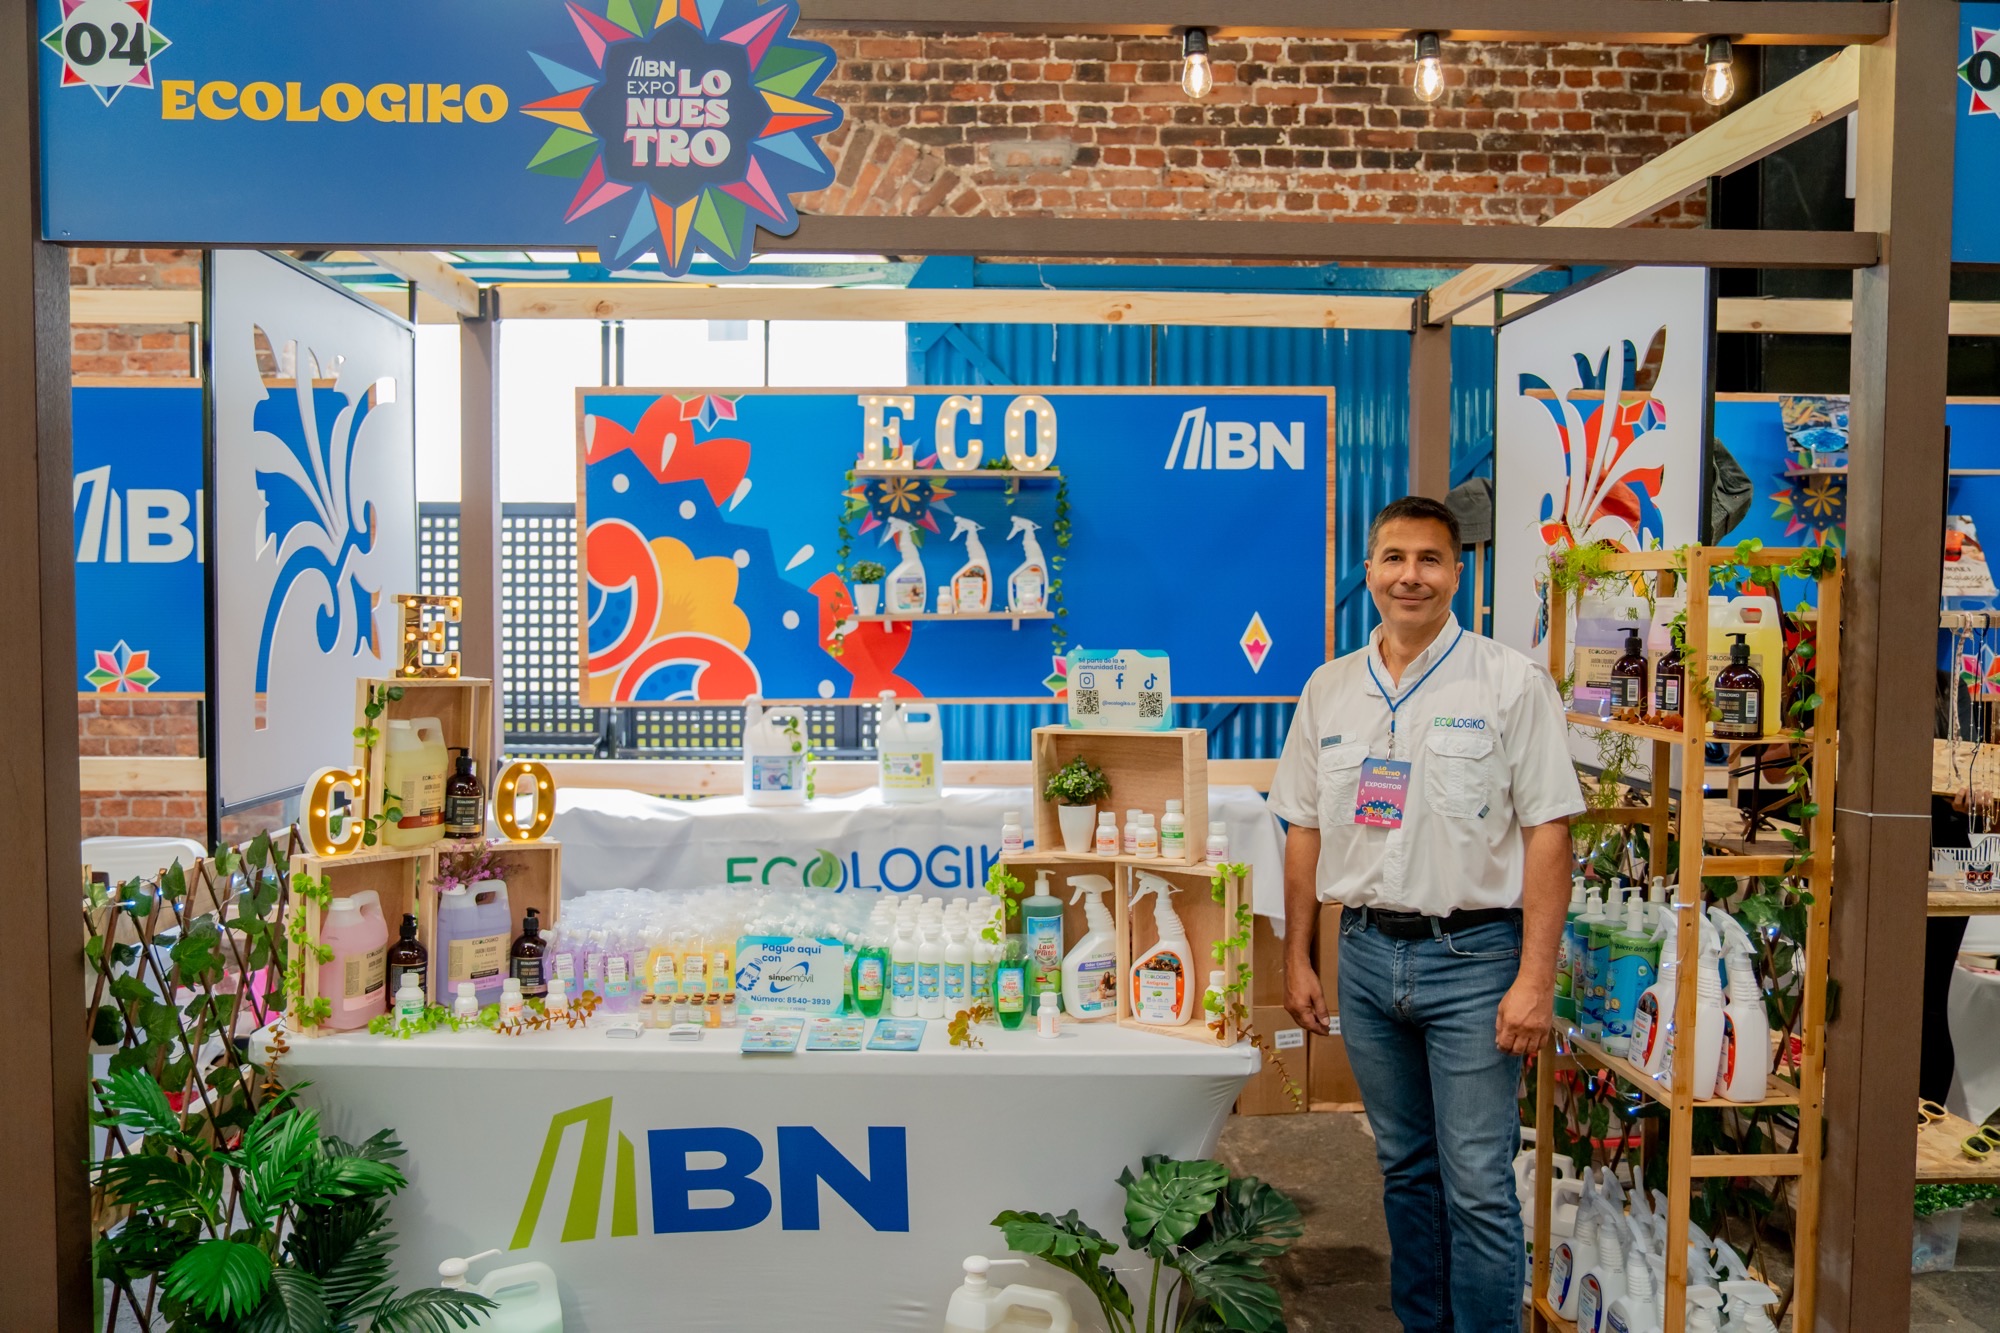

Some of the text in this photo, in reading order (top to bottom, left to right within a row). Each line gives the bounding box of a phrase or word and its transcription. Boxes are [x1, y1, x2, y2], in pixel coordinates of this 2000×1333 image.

[65, 22, 148, 66] 04
[645, 60, 676, 77] BN
[678, 69, 732, 97] LO
[161, 80, 509, 123] ECOLOGIKO
[627, 81, 676, 95] EXPO
[626, 98, 730, 128] NUES
[624, 128, 731, 168] TRO
[857, 394, 1058, 472] ECO
[1215, 421, 1306, 471] BN
[126, 488, 205, 563] B
[1433, 716, 1486, 730] ECOLOGIKO
[1364, 780, 1402, 791] EXPOSITOR
[727, 839, 1034, 894] ECOLOGIK
[761, 955, 782, 963] con
[762, 943, 822, 957] Pague aquí
[750, 994, 832, 1006] Número: 8540-3939
[647, 1126, 910, 1235] BN
